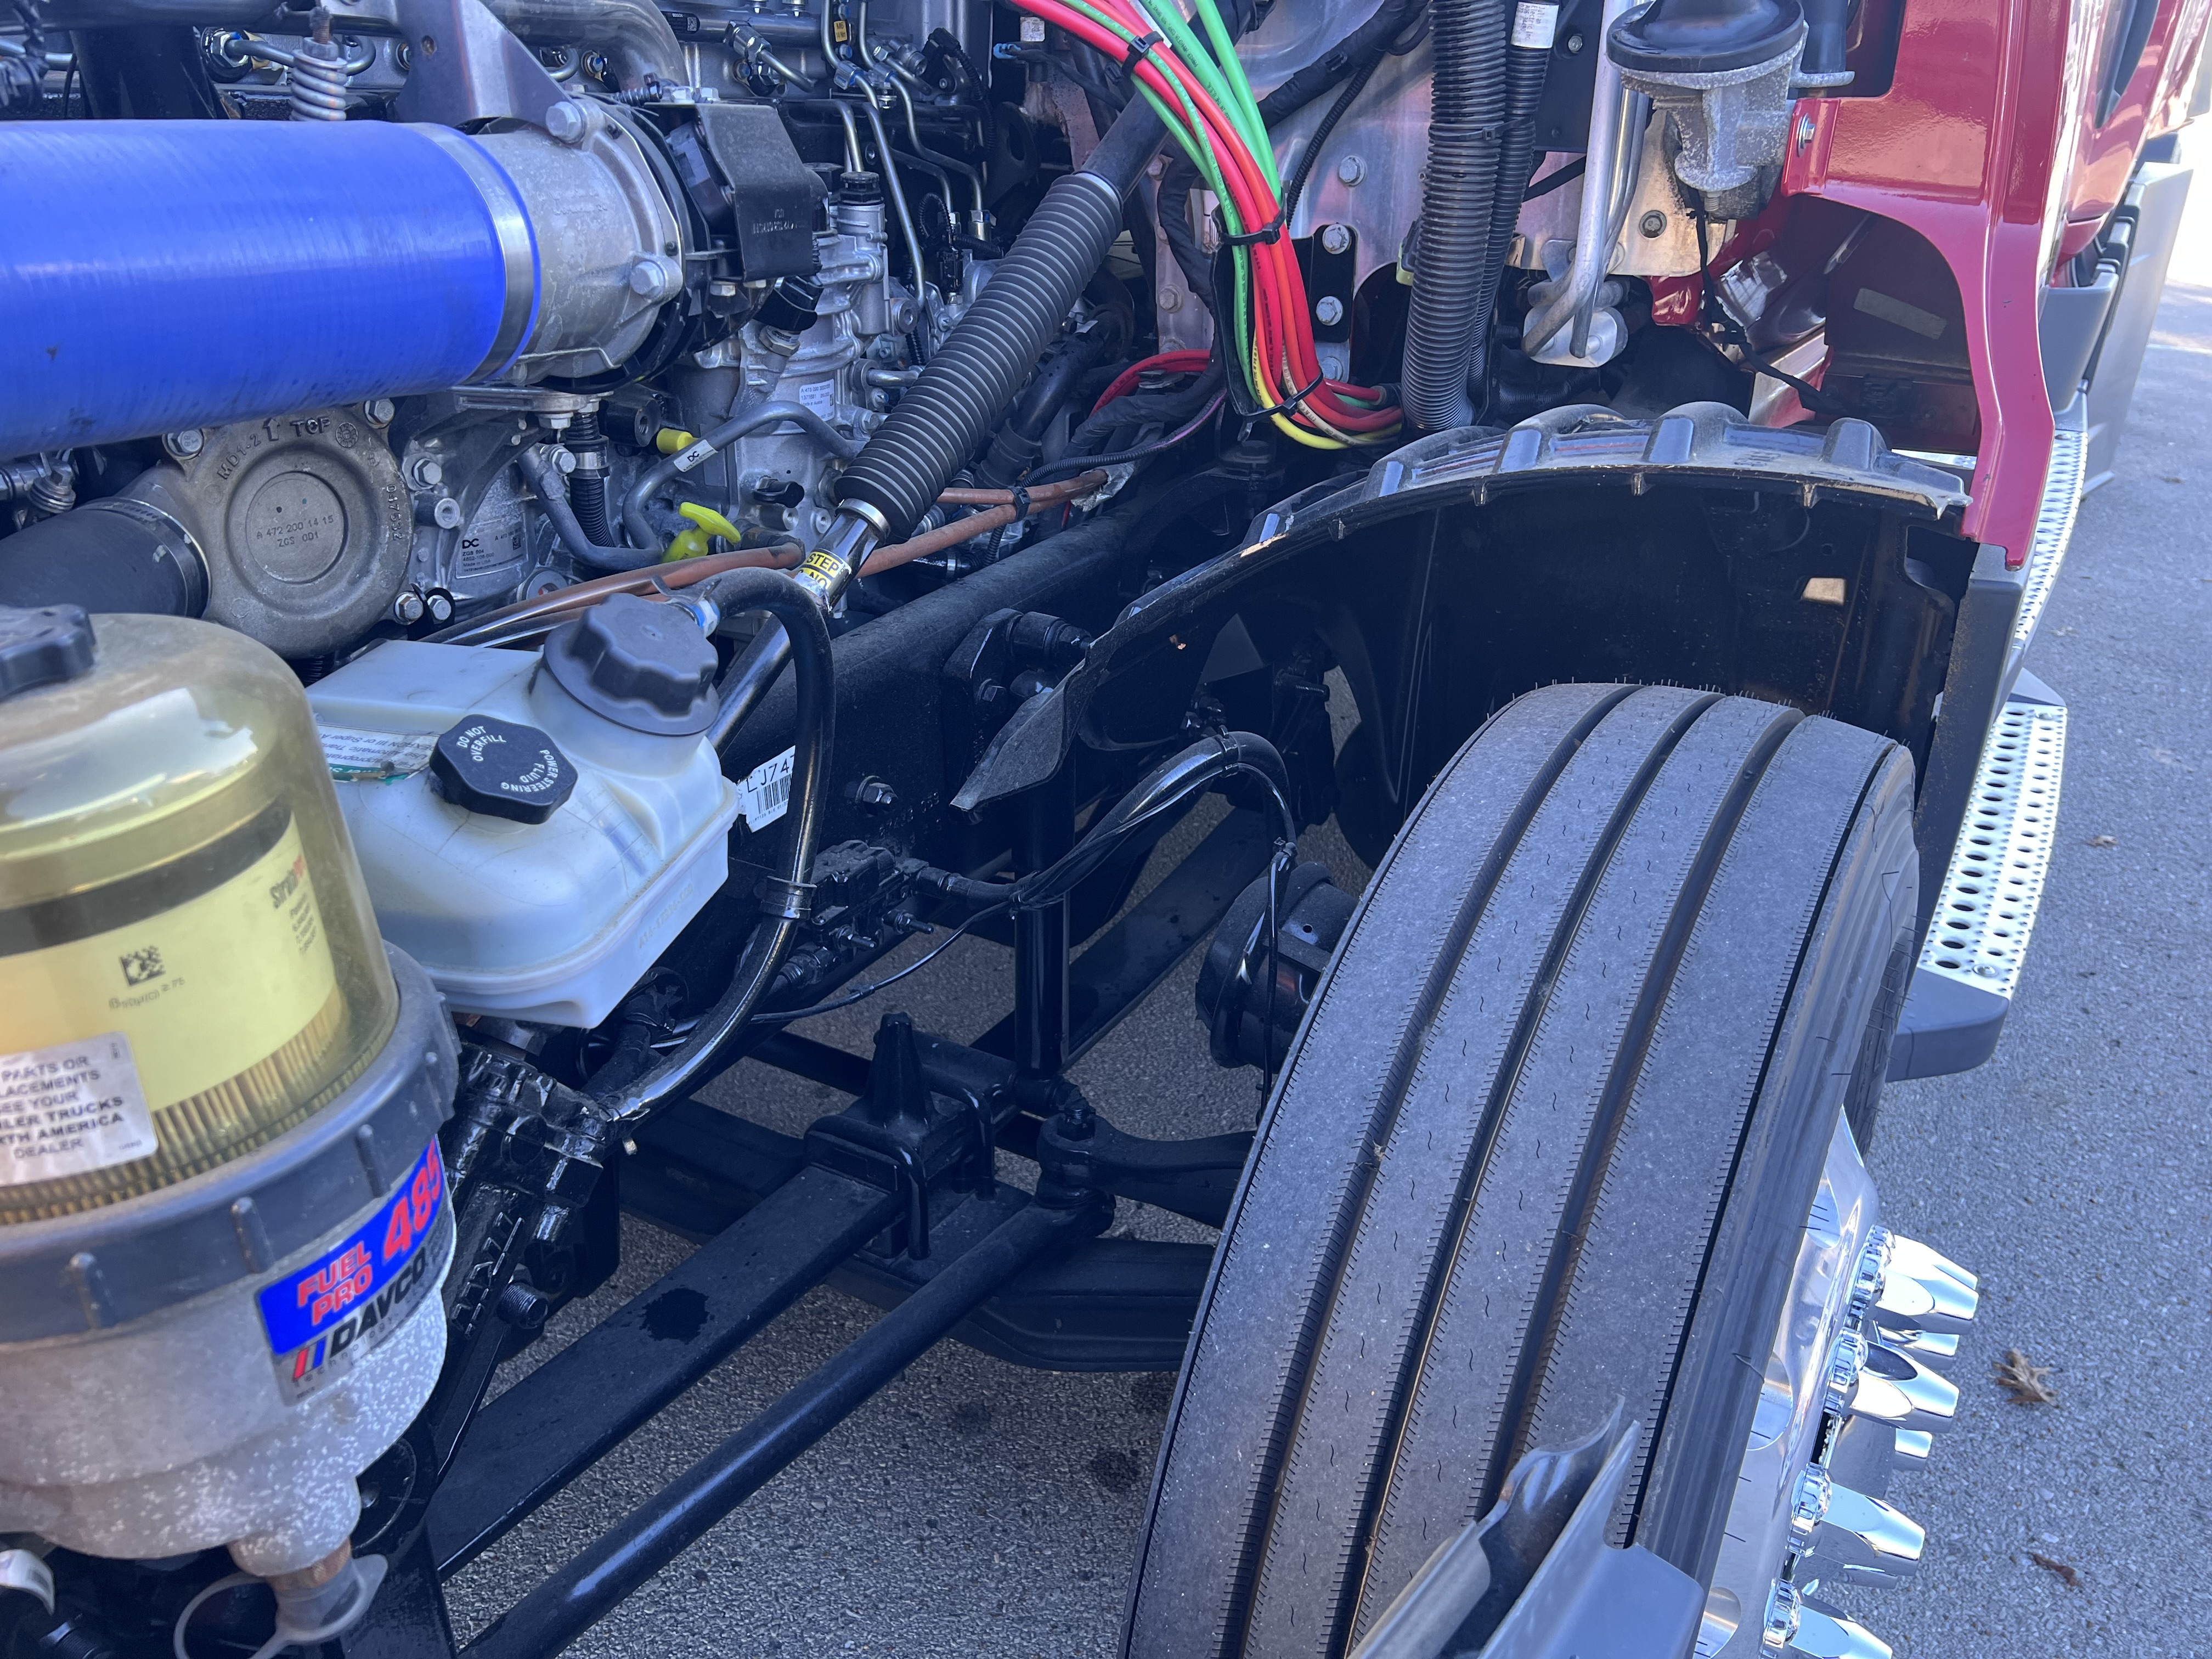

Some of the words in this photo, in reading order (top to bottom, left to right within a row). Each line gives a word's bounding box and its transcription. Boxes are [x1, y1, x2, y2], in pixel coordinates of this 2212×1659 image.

[1536, 7, 1545, 24] Julian
[289, 415, 331, 437] TOP
[217, 433, 262, 479] MD1-2
[686, 450, 701, 462] DC
[256, 530, 263, 540] A
[266, 524, 283, 537] 472
[286, 521, 304, 533] 200
[308, 517, 319, 528] 14
[323, 515, 334, 525] 15
[277, 535, 295, 548] ZGS
[462, 538, 479, 549] DC
[806, 553, 839, 571] STEP
[329, 733, 363, 743] Super
[456, 735, 470, 748] DO
[464, 725, 487, 738] NOT
[470, 733, 506, 762] OVERFILL
[348, 746, 402, 757] Automatic
[404, 752, 427, 760] Use
[518, 762, 545, 783] FLUID
[539, 749, 559, 778] POWER
[500, 777, 555, 793] STEERING
[1, 1063, 58, 1082] PARTS
[63, 1056, 89, 1070] OR
[28, 1090, 78, 1109] YOUR
[44, 1096, 124, 1122] TRUCKS
[38, 1112, 124, 1139] AMERICA
[13, 1138, 84, 1160] DEALER
[297, 1240, 372, 1307] FUEL
[385, 1138, 439, 1260] 485
[312, 1263, 373, 1326] PRO
[330, 1246, 426, 1358] DAVCO
